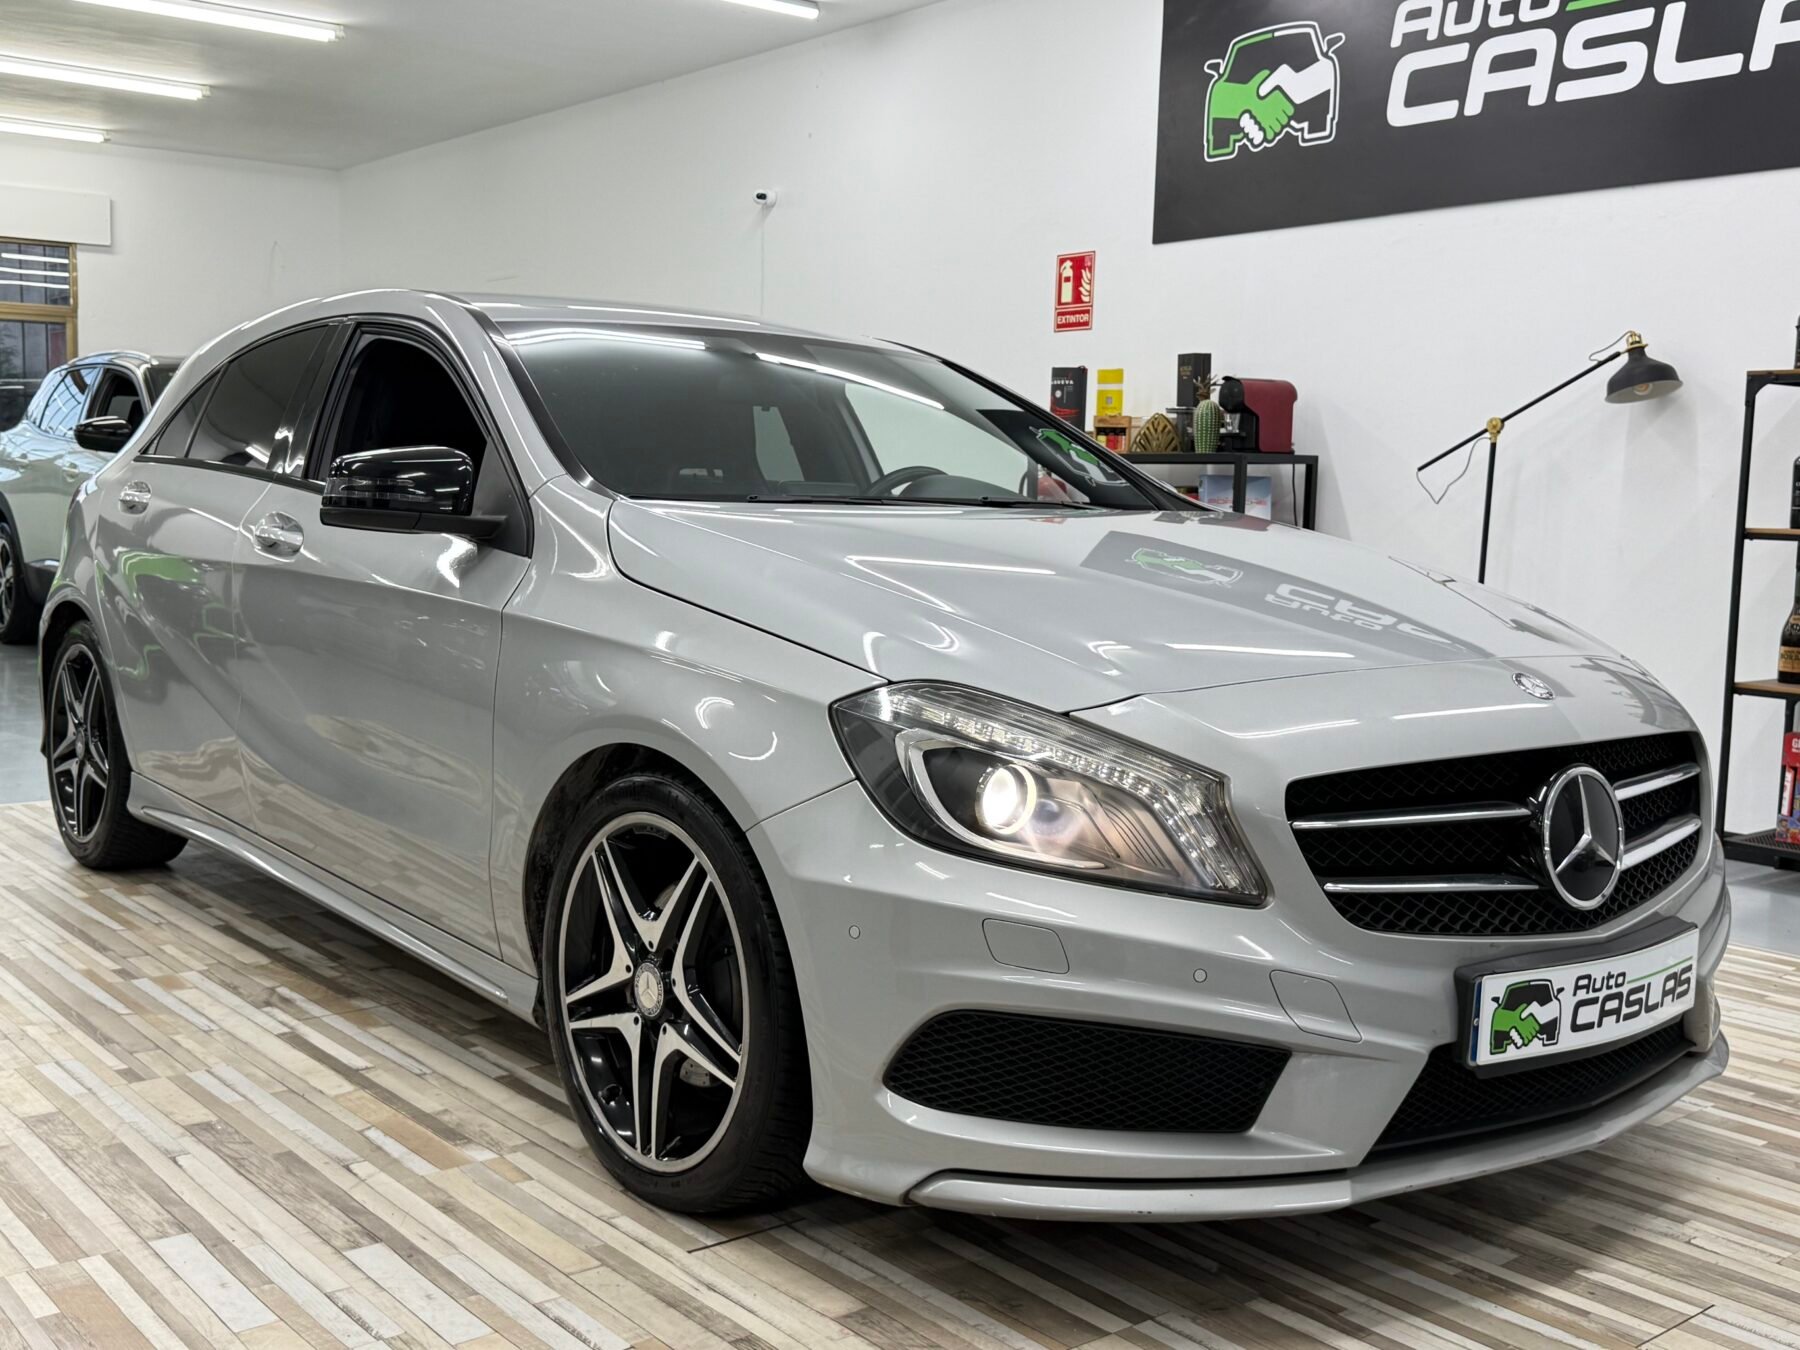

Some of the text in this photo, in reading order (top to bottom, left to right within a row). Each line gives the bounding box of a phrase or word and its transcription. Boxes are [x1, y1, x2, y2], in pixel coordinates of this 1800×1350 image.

[1057, 313, 1089, 325] EXTINTOR
[1572, 971, 1627, 997] Auto
[1570, 963, 1693, 1033] CASLAS
